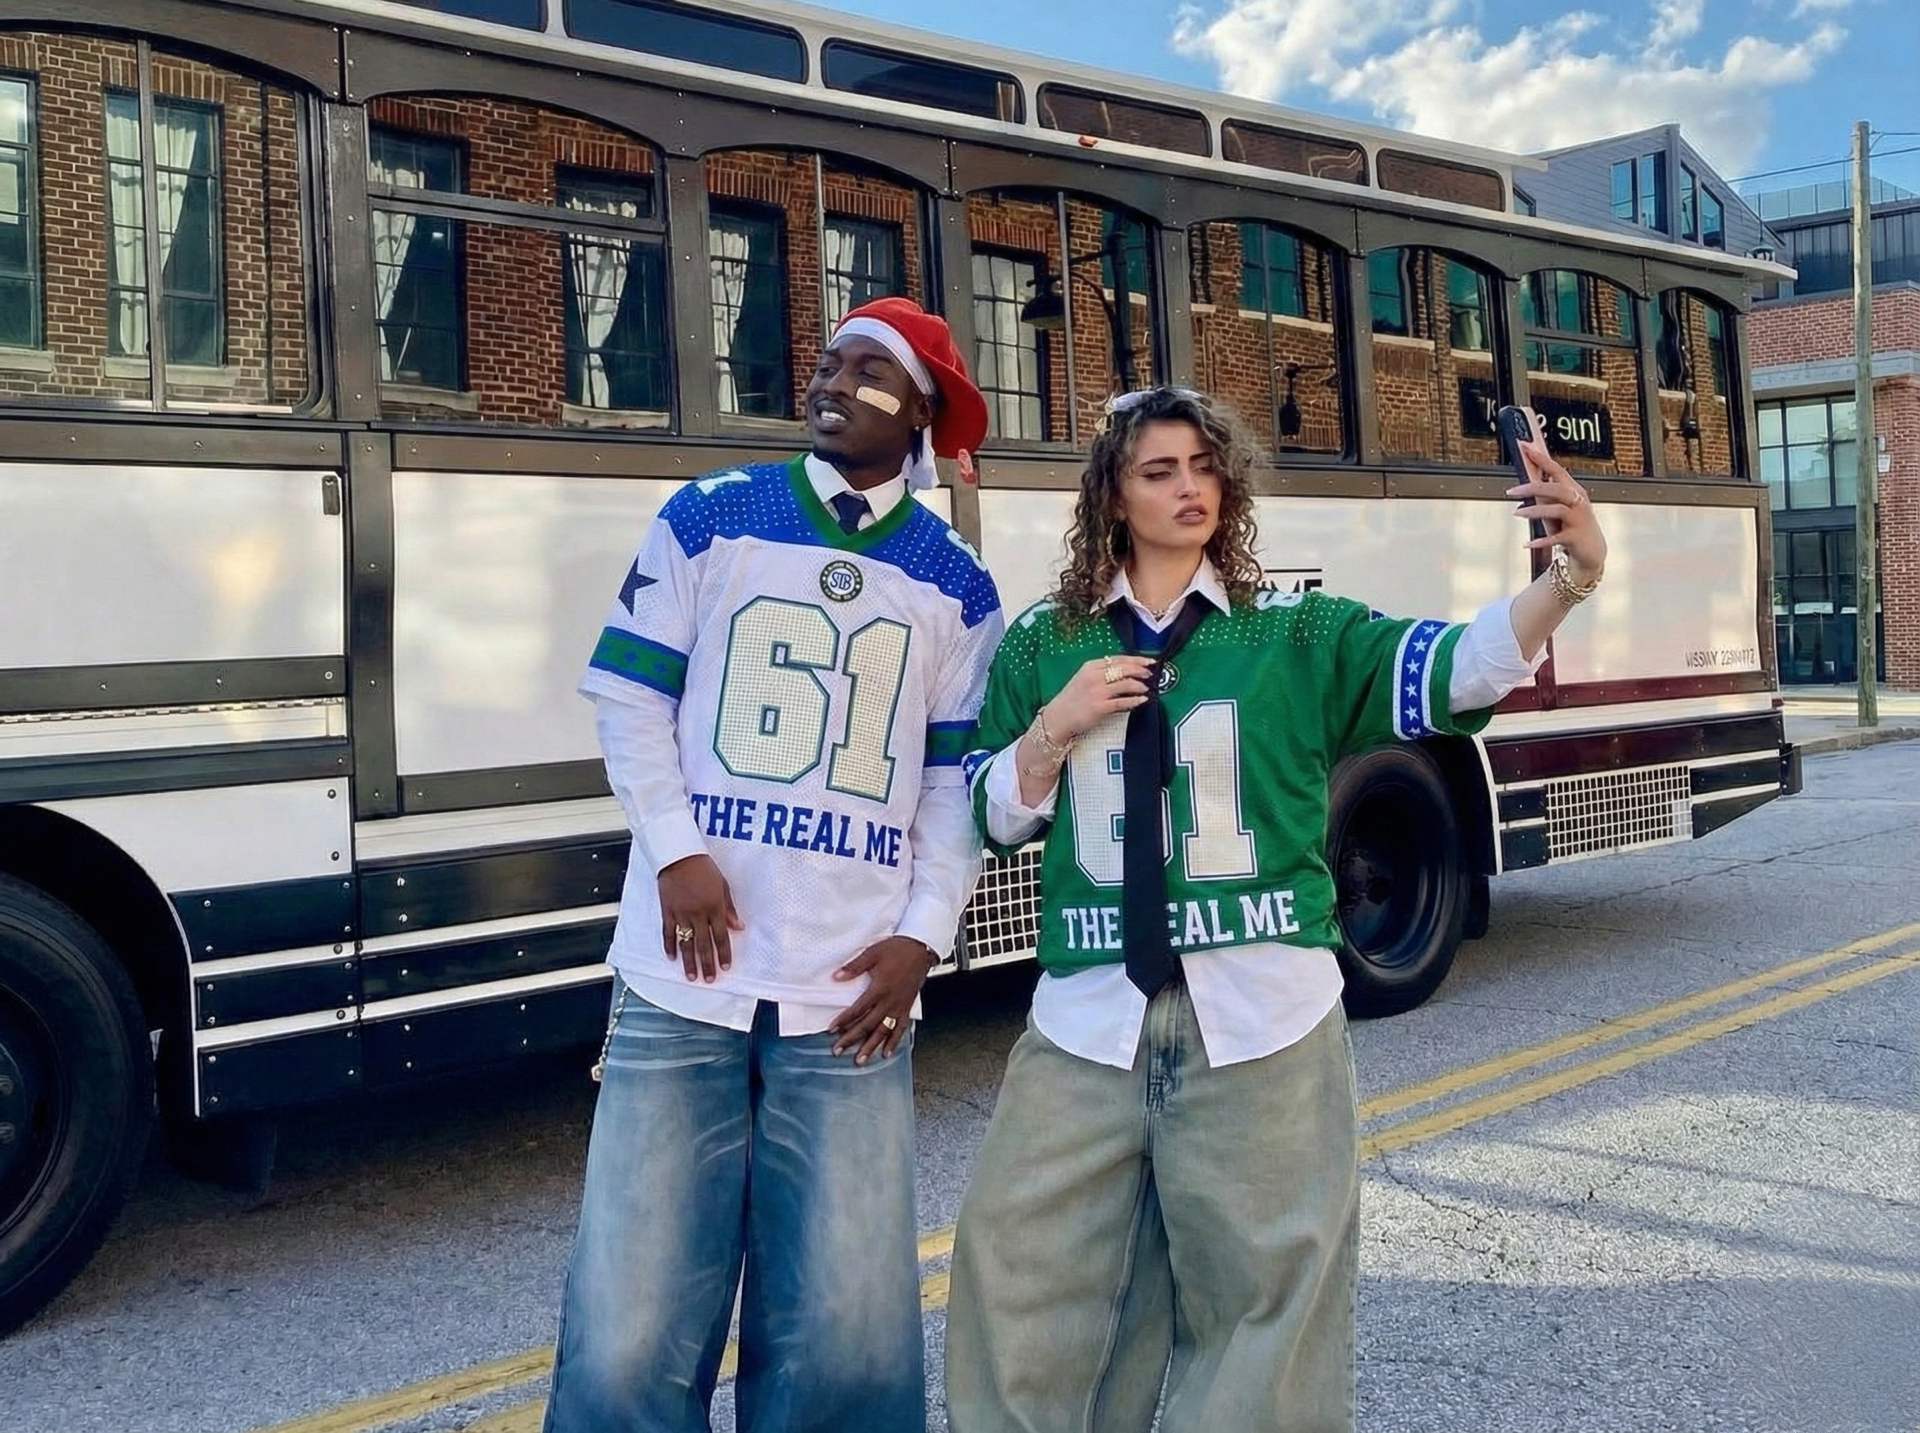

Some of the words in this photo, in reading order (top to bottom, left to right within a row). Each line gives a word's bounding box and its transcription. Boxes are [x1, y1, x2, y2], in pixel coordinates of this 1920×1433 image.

[713, 595, 912, 804] 61
[691, 793, 757, 841] THE
[762, 802, 856, 858] REAL
[864, 821, 902, 867] ME
[1061, 906, 1123, 950] THE
[1166, 899, 1235, 947] EAL
[1239, 889, 1300, 939] ME
